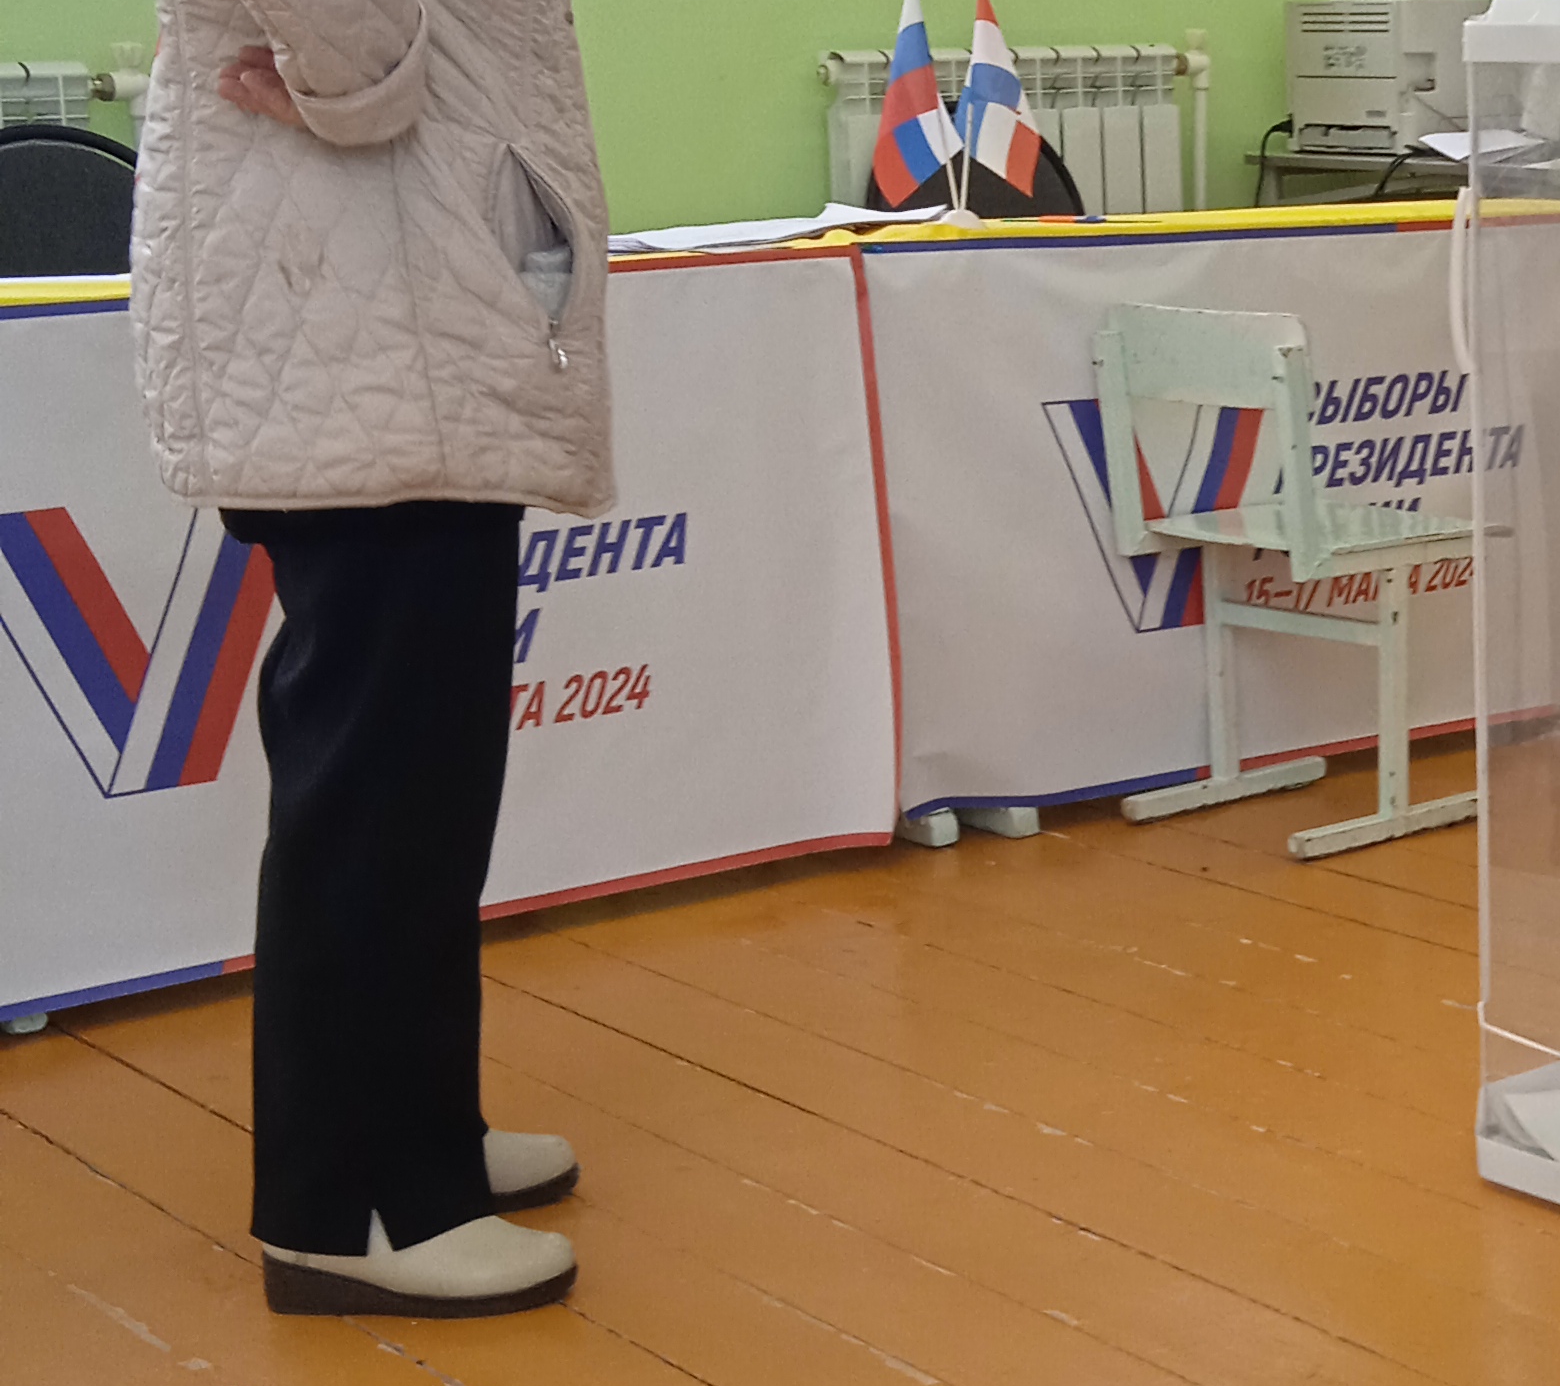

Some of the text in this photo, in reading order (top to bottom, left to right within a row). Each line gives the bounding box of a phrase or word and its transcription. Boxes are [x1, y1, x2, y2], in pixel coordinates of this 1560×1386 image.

[1272, 424, 1526, 494] РЕЗИДЕНТА
[1425, 556, 1474, 593] 202
[554, 664, 651, 724] 2024
